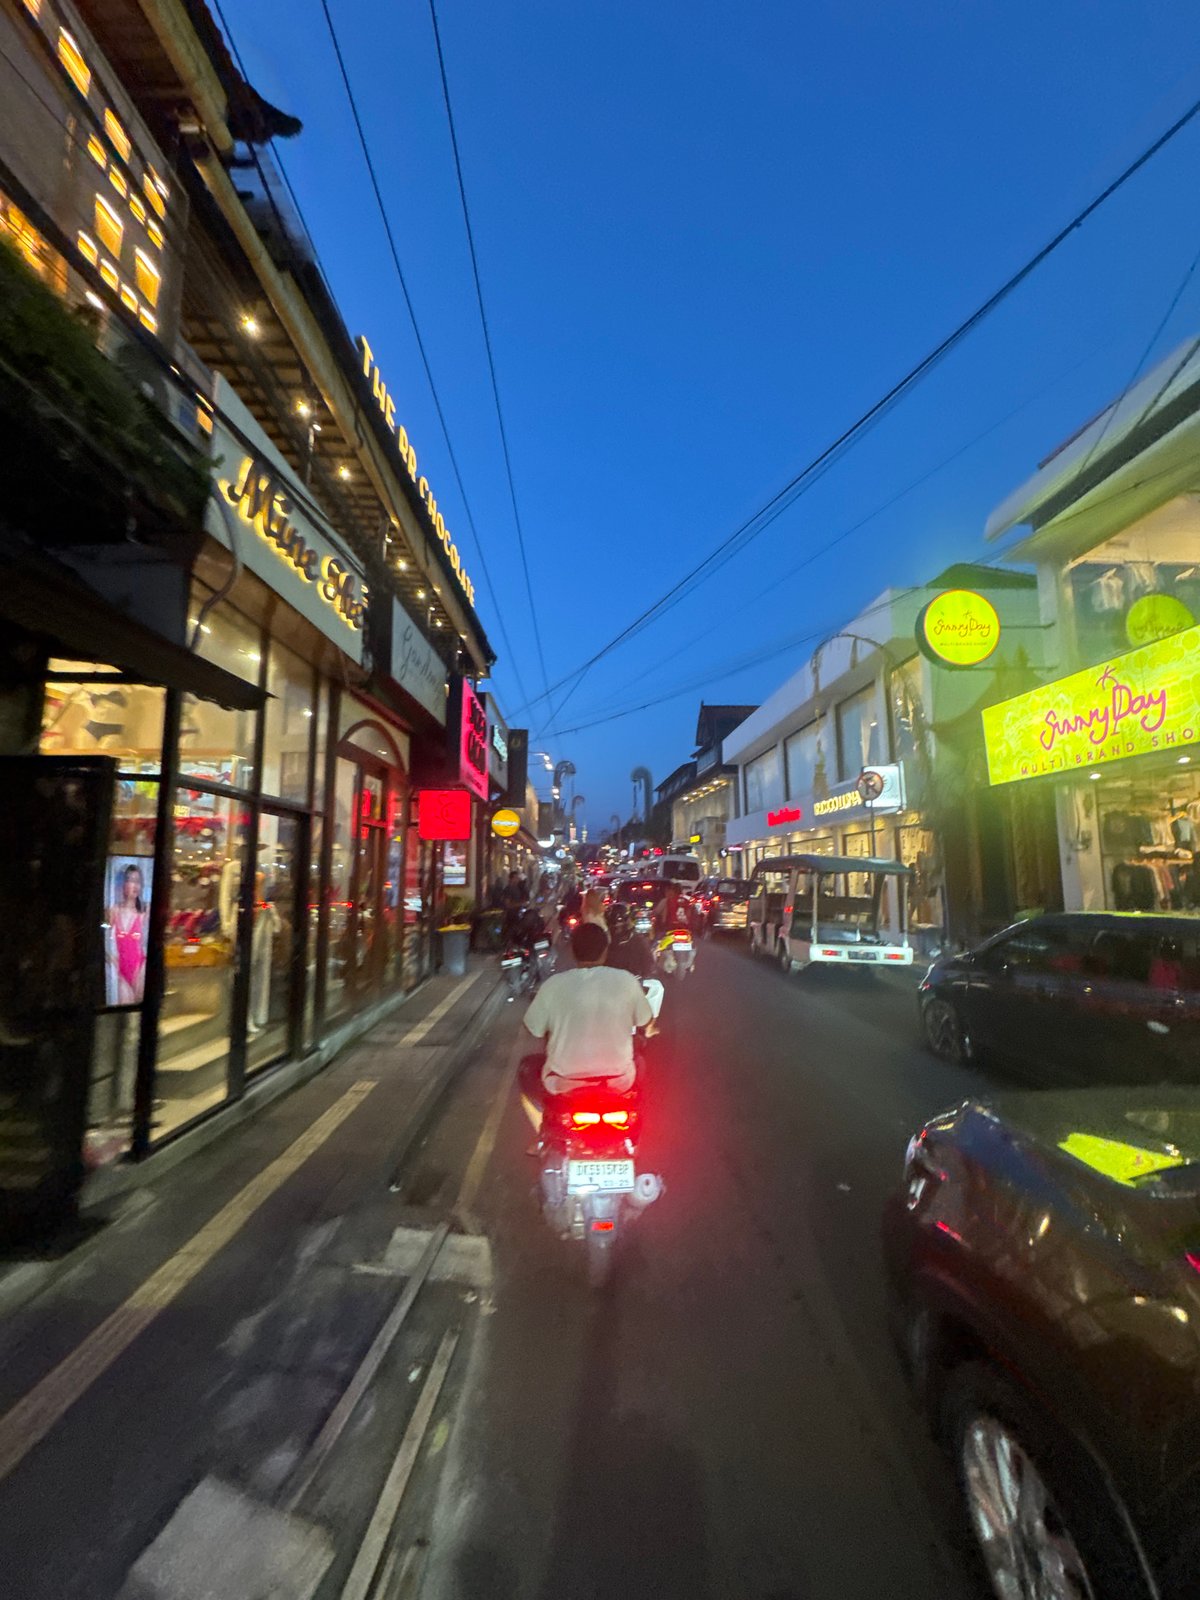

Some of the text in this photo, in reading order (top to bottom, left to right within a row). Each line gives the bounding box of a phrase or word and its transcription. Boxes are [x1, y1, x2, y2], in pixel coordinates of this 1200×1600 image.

[217, 457, 319, 583] Mine
[359, 334, 396, 434] THE
[419, 476, 475, 608] CHOCOLATE
[1020, 728, 1200, 776] MULTI BRAND SHO
